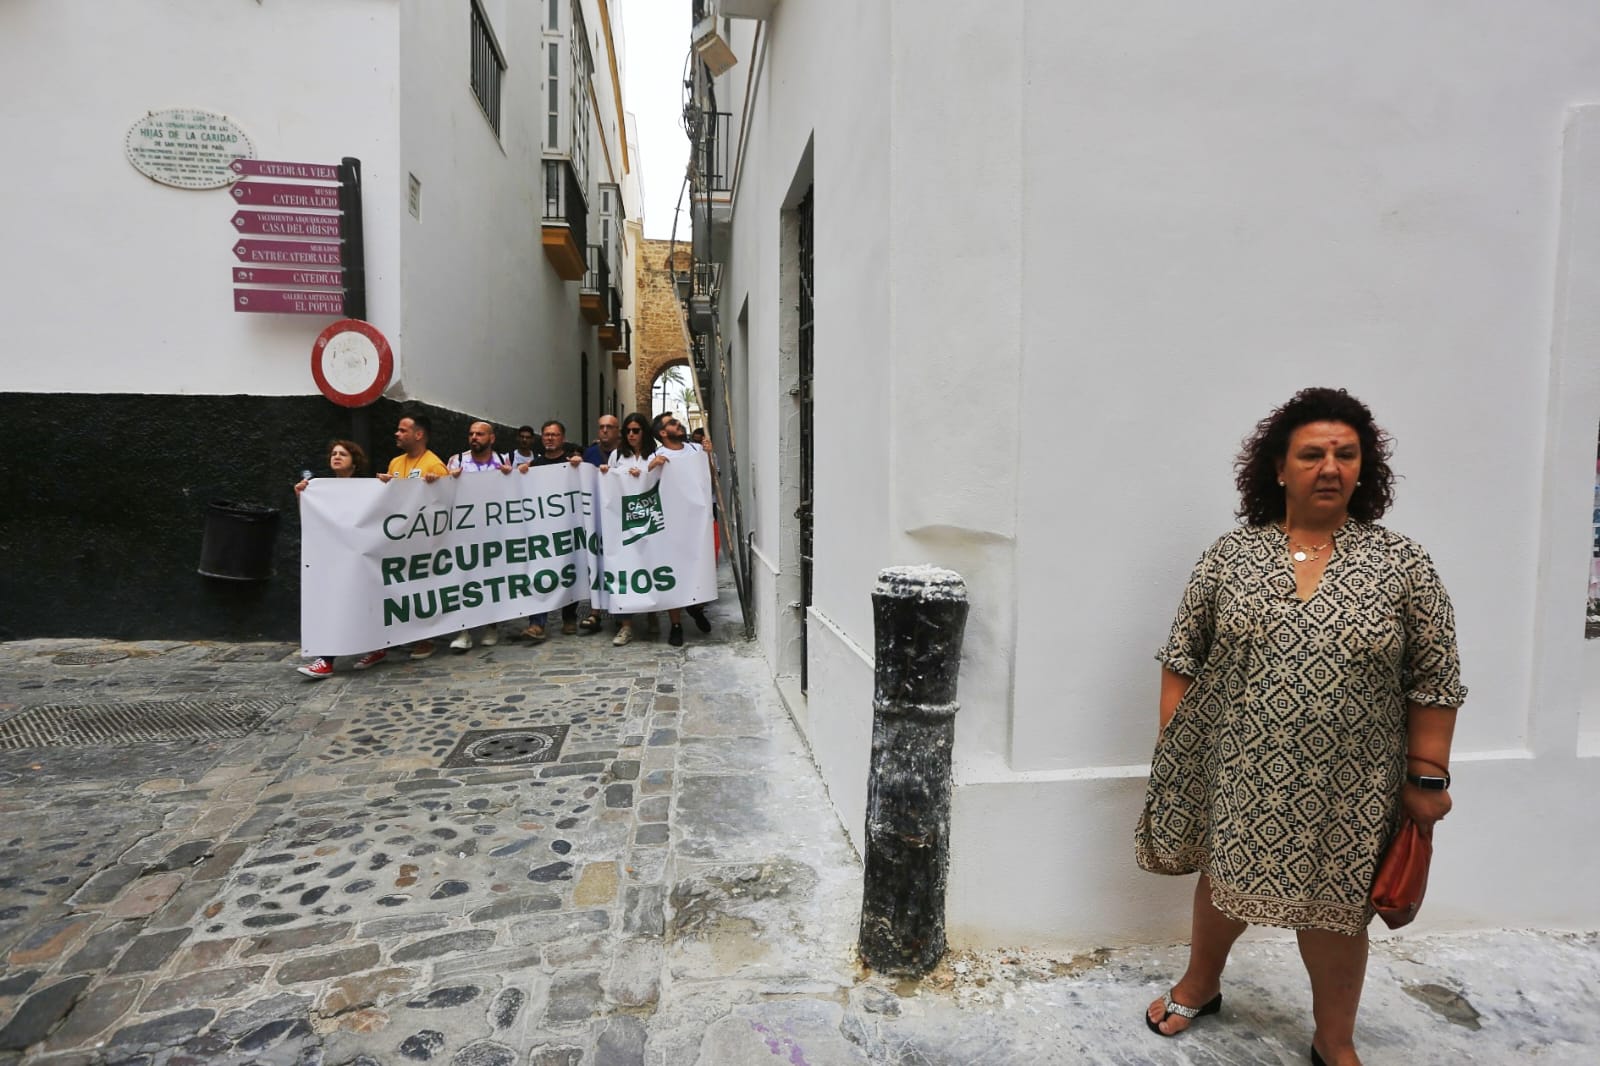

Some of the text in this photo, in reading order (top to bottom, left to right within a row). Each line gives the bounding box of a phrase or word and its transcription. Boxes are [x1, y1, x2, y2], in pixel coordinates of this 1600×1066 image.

[140, 128, 238, 143] HIJAS DE LA CARIDAD
[259, 164, 337, 178] CATEDRAL VIEJA
[273, 194, 338, 207] CATEDRALICIO
[257, 214, 338, 225] YACIMIENTO ARQUEOLÓGICO
[262, 223, 338, 236] CASA DEL OBISPO
[252, 250, 340, 264] ENTRECATEDRALES
[293, 273, 341, 285] CATEDRAL
[295, 301, 307, 311] EL
[383, 490, 593, 541] CÁDIZ RESISTE
[383, 563, 577, 627] NUESTROS
